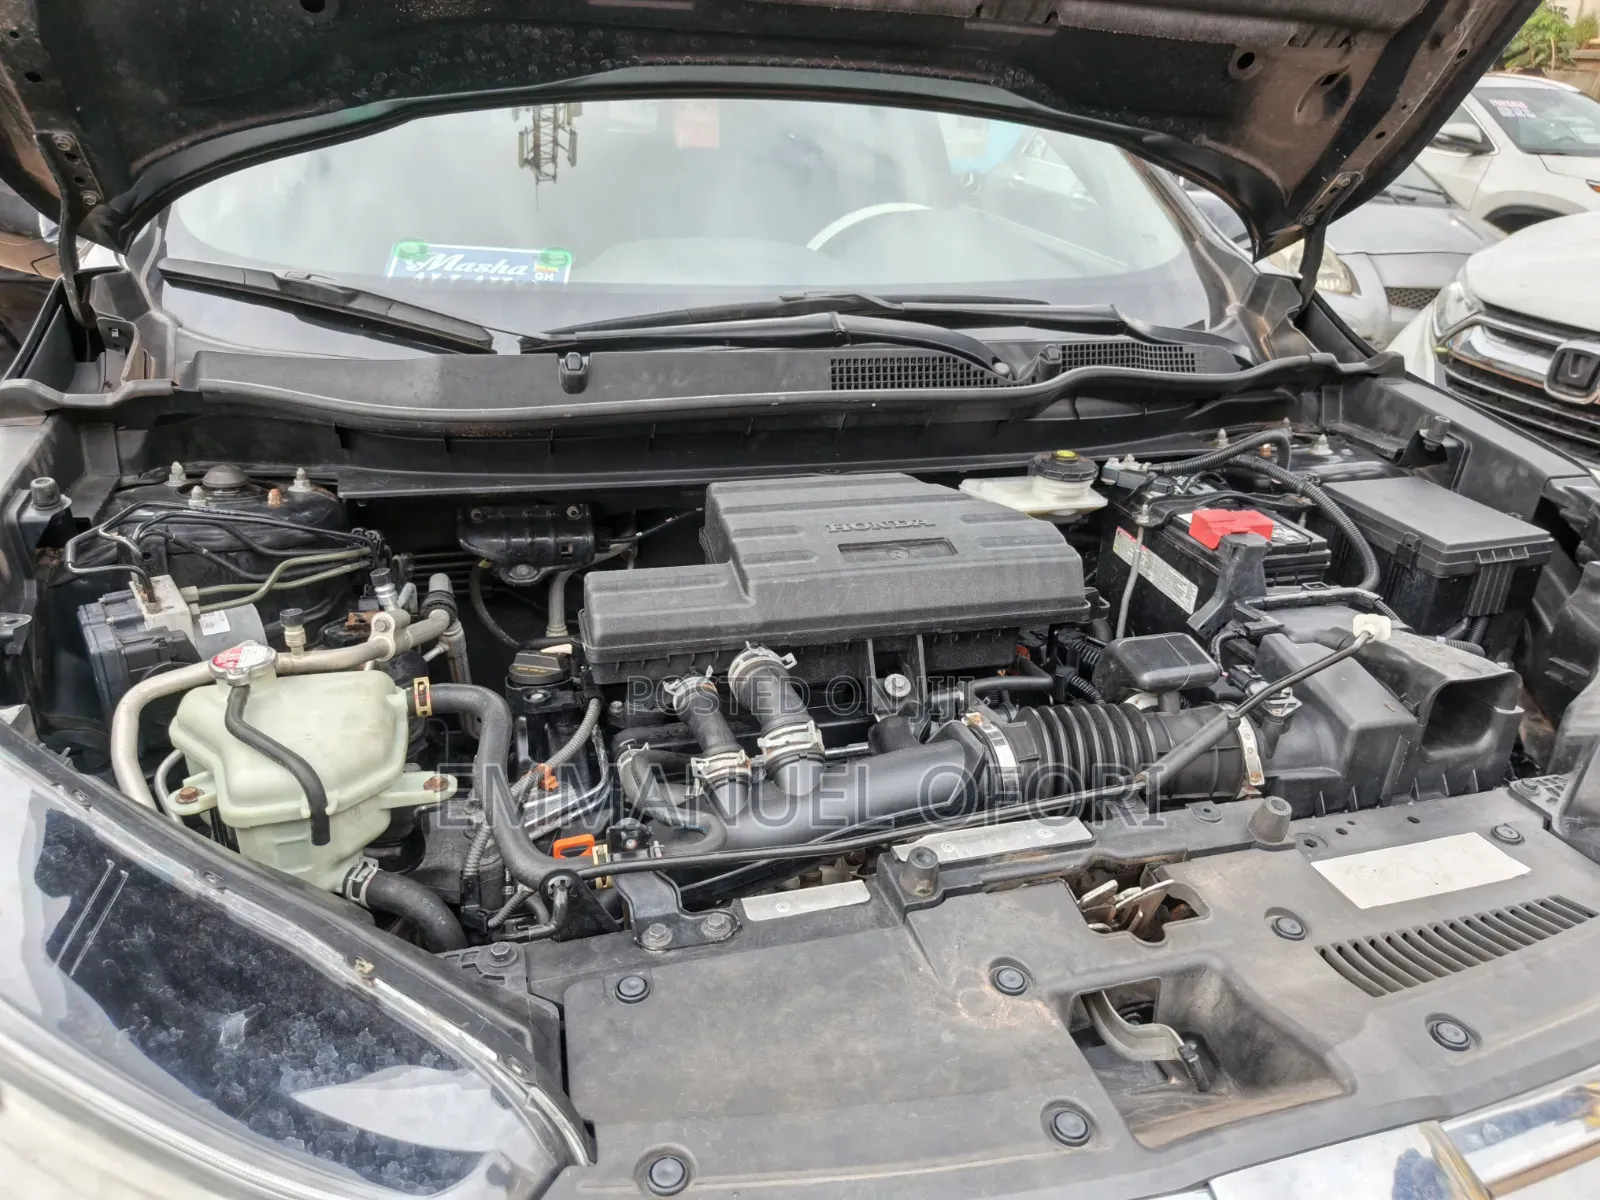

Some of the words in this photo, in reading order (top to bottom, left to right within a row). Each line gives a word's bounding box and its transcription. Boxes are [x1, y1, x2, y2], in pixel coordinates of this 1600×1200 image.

[405, 253, 528, 276] Masha
[534, 272, 554, 282] GH
[826, 519, 936, 533] HONDA
